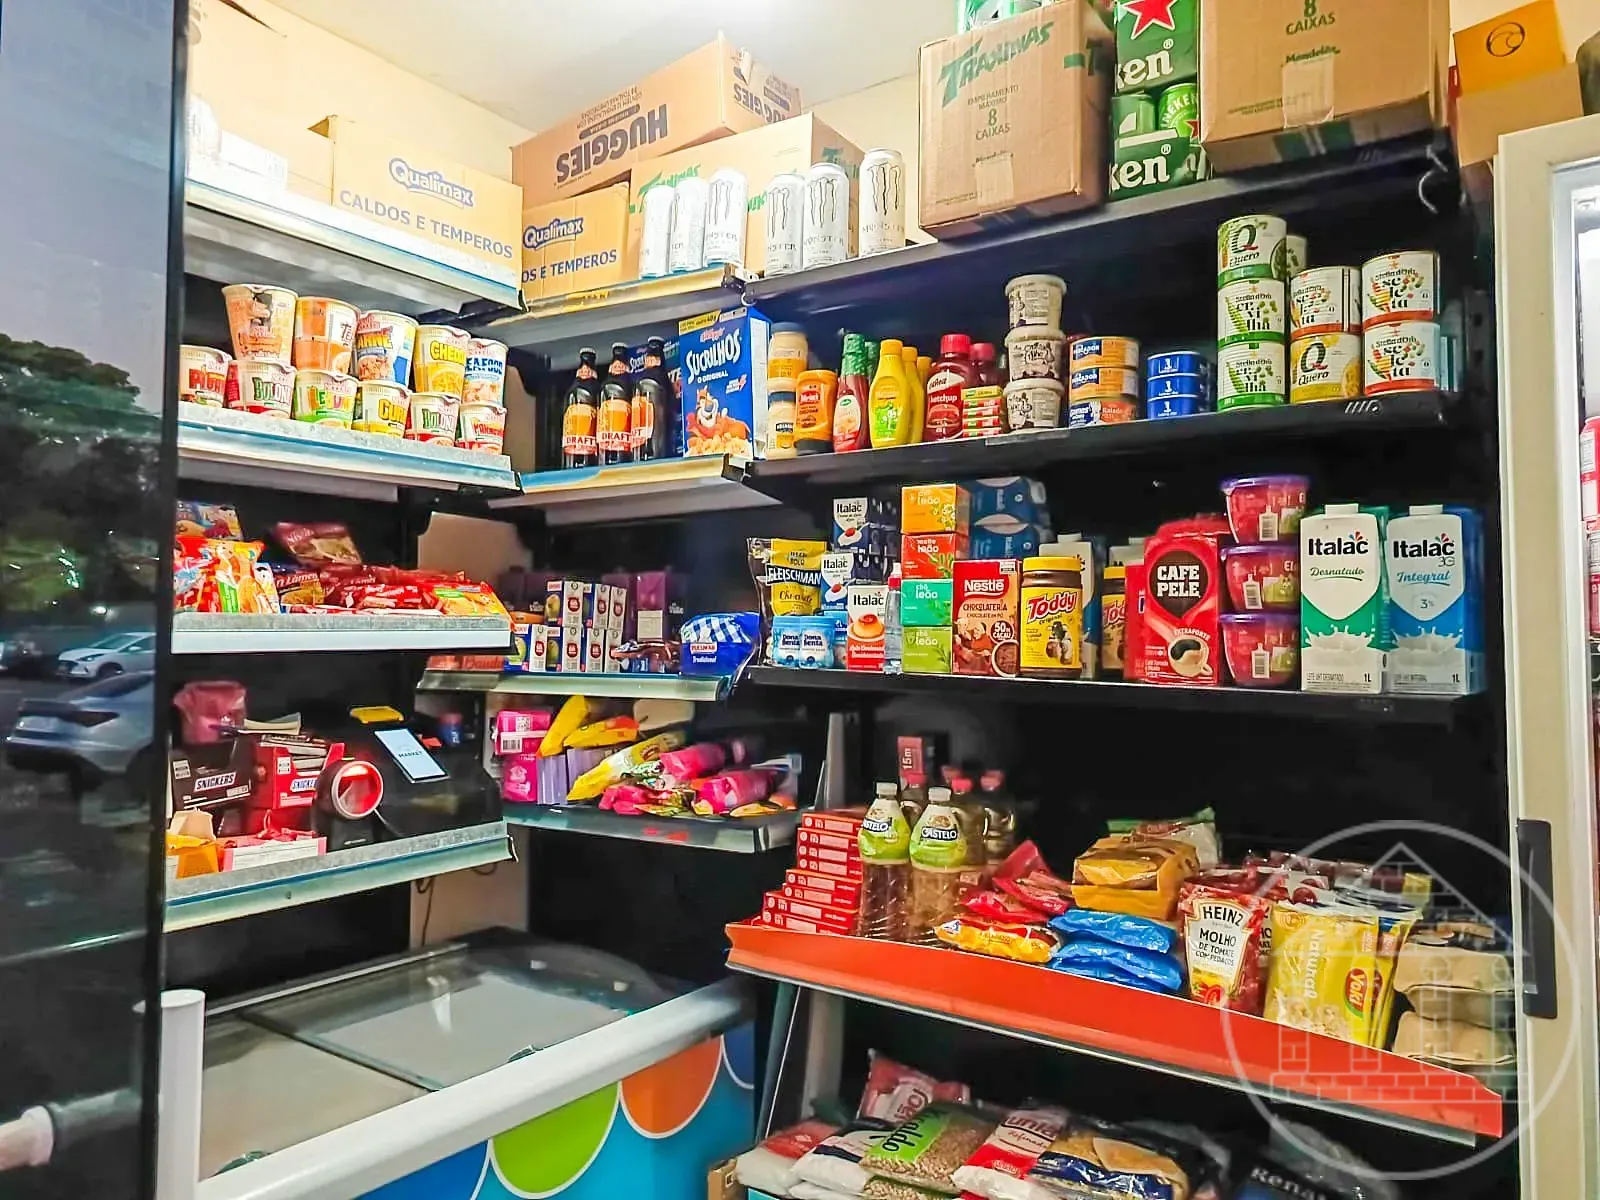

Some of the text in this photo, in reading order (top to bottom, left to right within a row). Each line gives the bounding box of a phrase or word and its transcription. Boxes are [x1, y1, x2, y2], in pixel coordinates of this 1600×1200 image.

[1286, 12, 1336, 35] CAIXAS
[988, 108, 997, 126] 8
[975, 125, 1010, 141] CAIXAS
[556, 103, 668, 183] HUGGIES
[388, 157, 474, 208] Qualimax
[339, 189, 513, 259] CALDOS E TEMPEROS
[523, 217, 584, 250] Qualimax
[540, 265, 547, 279] E
[550, 249, 617, 276] TEMPEROS
[1229, 251, 1260, 267] Quero
[686, 328, 741, 385] SUCRILHOS
[697, 369, 729, 384] O ORIGINAL
[1298, 370, 1329, 386] Quero
[930, 393, 958, 404] ketchup
[566, 436, 594, 446] DRAFT
[601, 431, 631, 442] DRAFT
[836, 503, 862, 514] Italac
[1307, 537, 1369, 556] Italac
[1392, 539, 1455, 558] Italac
[823, 557, 848, 570] Italac
[1310, 566, 1365, 578] Desnatado
[1396, 569, 1450, 585] Integral
[853, 593, 884, 606] Italac
[1027, 591, 1078, 624] Toddy
[992, 631, 1011, 639] CACAU
[1363, 673, 1372, 683] 1L
[1452, 674, 1460, 683] 1L
[196, 773, 236, 791] SNICKERS
[922, 827, 958, 841] CASTELO
[1202, 905, 1244, 927] HEINZ
[1199, 927, 1237, 947] MOLHO
[1198, 942, 1235, 958] DE TOMATE
